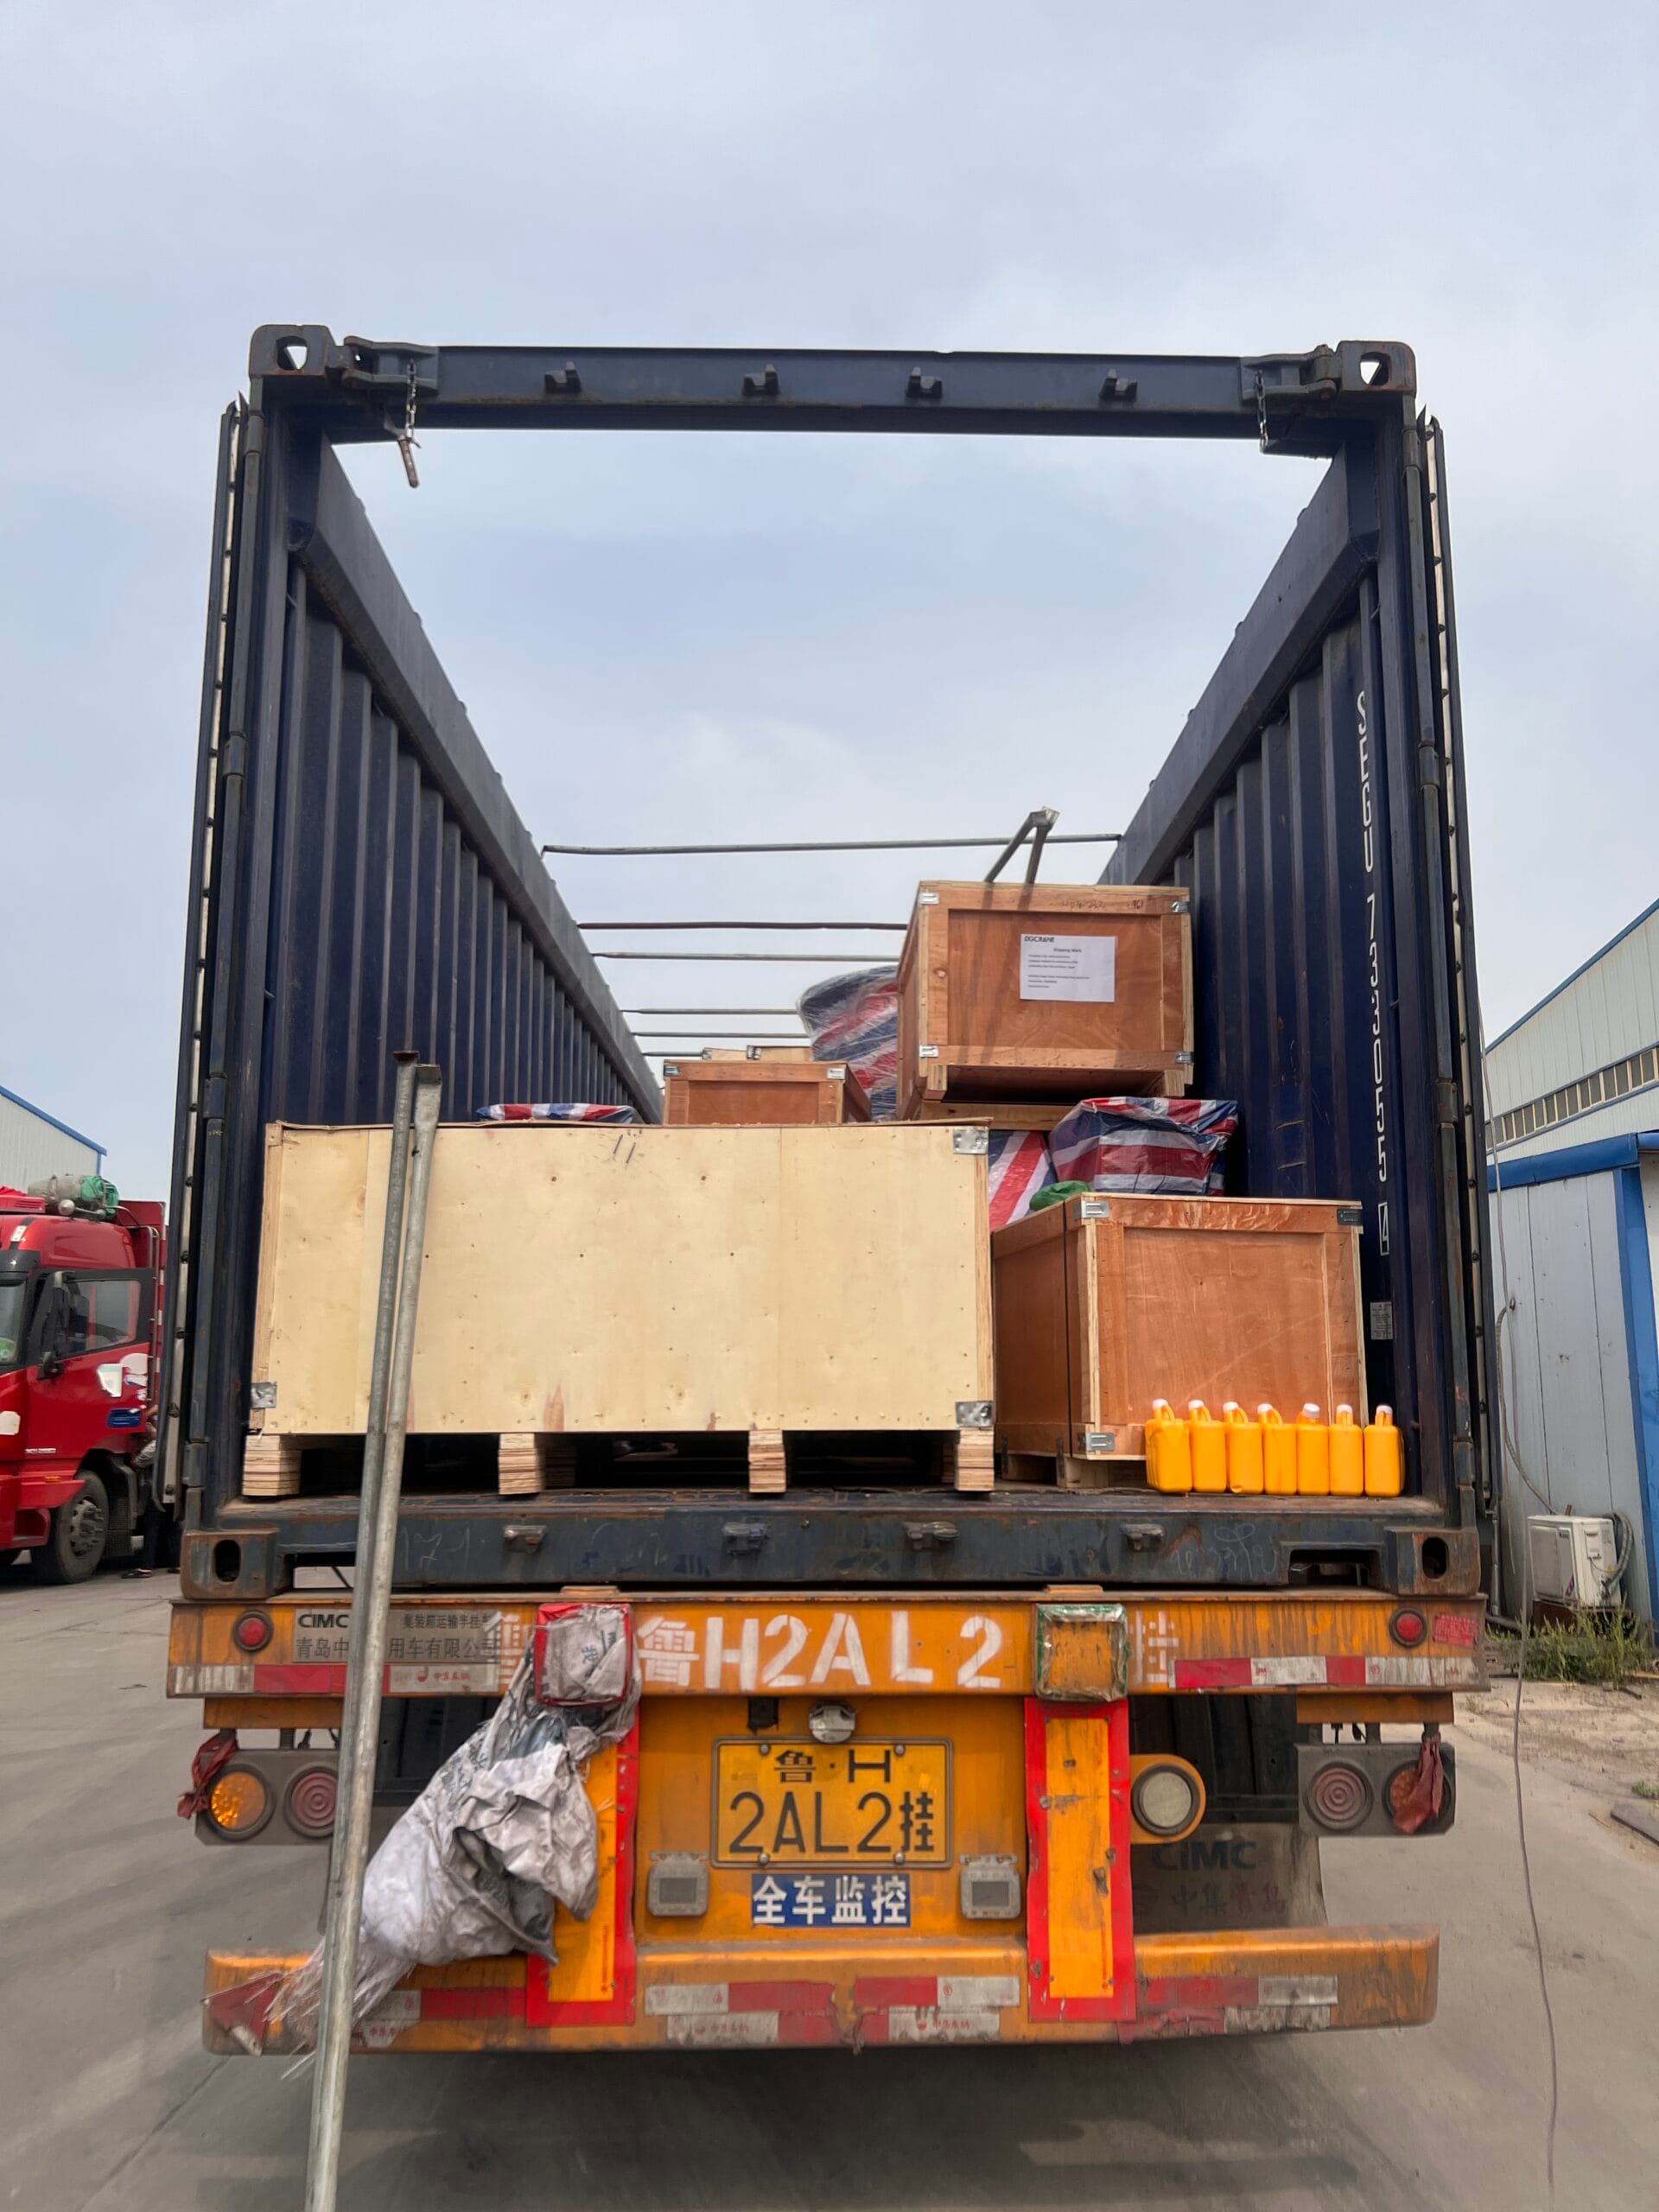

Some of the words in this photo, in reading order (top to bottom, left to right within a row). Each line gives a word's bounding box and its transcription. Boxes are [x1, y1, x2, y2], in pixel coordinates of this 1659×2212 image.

[1356, 690, 1374, 873] SEGU
[1366, 893, 1387, 1183] 733055
[298, 1614, 349, 1629] CIMC
[729, 1791, 935, 1853] 2AL2挂
[1152, 1840, 1258, 1871] CIMC
[753, 1875, 908, 1925] 全车监控
